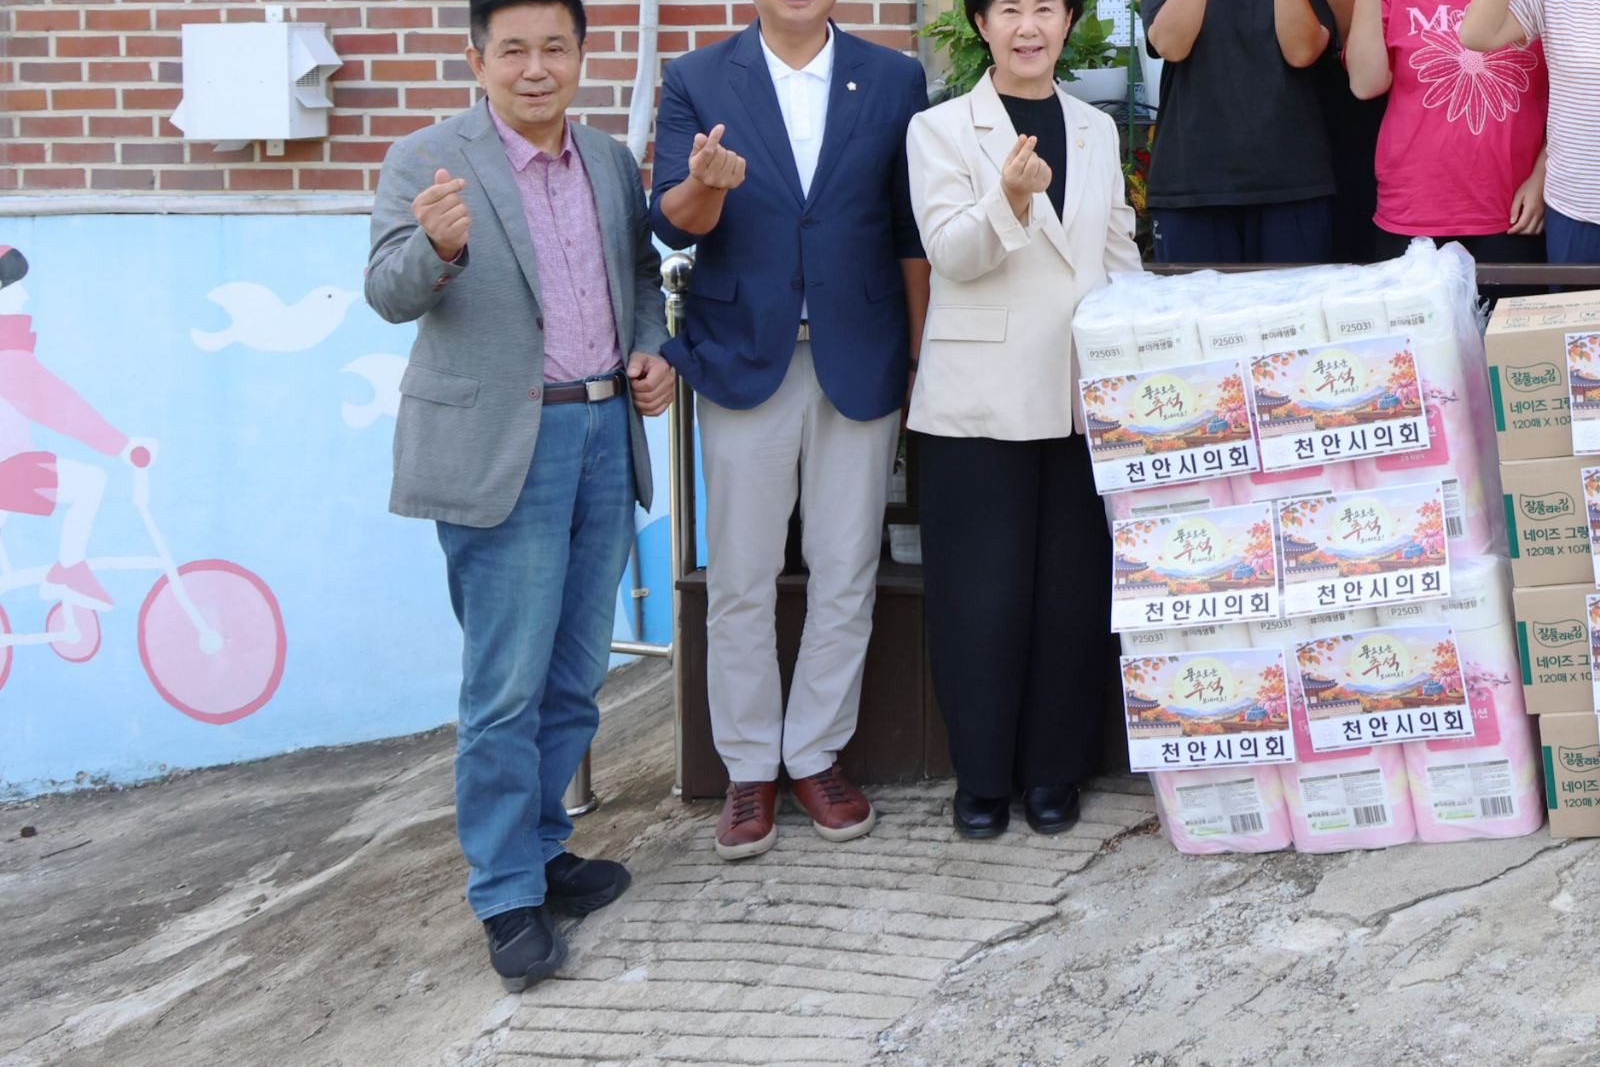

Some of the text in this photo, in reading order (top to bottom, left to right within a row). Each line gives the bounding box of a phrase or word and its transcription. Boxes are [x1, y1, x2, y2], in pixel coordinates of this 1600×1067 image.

[1261, 327, 1297, 340] #미래생활
[1340, 322, 1372, 333] P25031
[1138, 341, 1173, 353] #미래생활
[1212, 335, 1244, 346] P25031
[1089, 348, 1121, 359] P25031
[1316, 368, 1355, 394] 추석
[1511, 369, 1556, 387] 잘풀리는집
[1145, 393, 1183, 418] 추석
[1510, 399, 1548, 414] 네이즈
[1512, 418, 1541, 429] 120매
[1294, 421, 1420, 461] 천안시의회
[1126, 445, 1250, 484] 천안시의회
[1524, 497, 1569, 515] 잘풀리는집
[1342, 517, 1381, 542] 추석
[1524, 528, 1561, 541] 네이즈
[1173, 537, 1212, 562] 추석
[1526, 546, 1554, 557] 120매
[1318, 571, 1440, 606] 천안시의회
[1145, 592, 1269, 623] 천안시의회
[1391, 606, 1423, 616] P25031
[1260, 620, 1292, 631] P25031
[1310, 613, 1345, 624] #미래생활
[1133, 633, 1164, 643] P25031
[1539, 625, 1582, 642] 잘풀리는집
[1361, 653, 1400, 678] 추석
[1537, 655, 1574, 668] 네이즈
[1539, 673, 1567, 683] 120매
[1185, 678, 1223, 702] 추석
[1342, 709, 1465, 741] 천안시의회
[1161, 735, 1285, 764] 천안시의회
[1562, 780, 1599, 793] 네이즈
[1564, 798, 1592, 808] 120매
